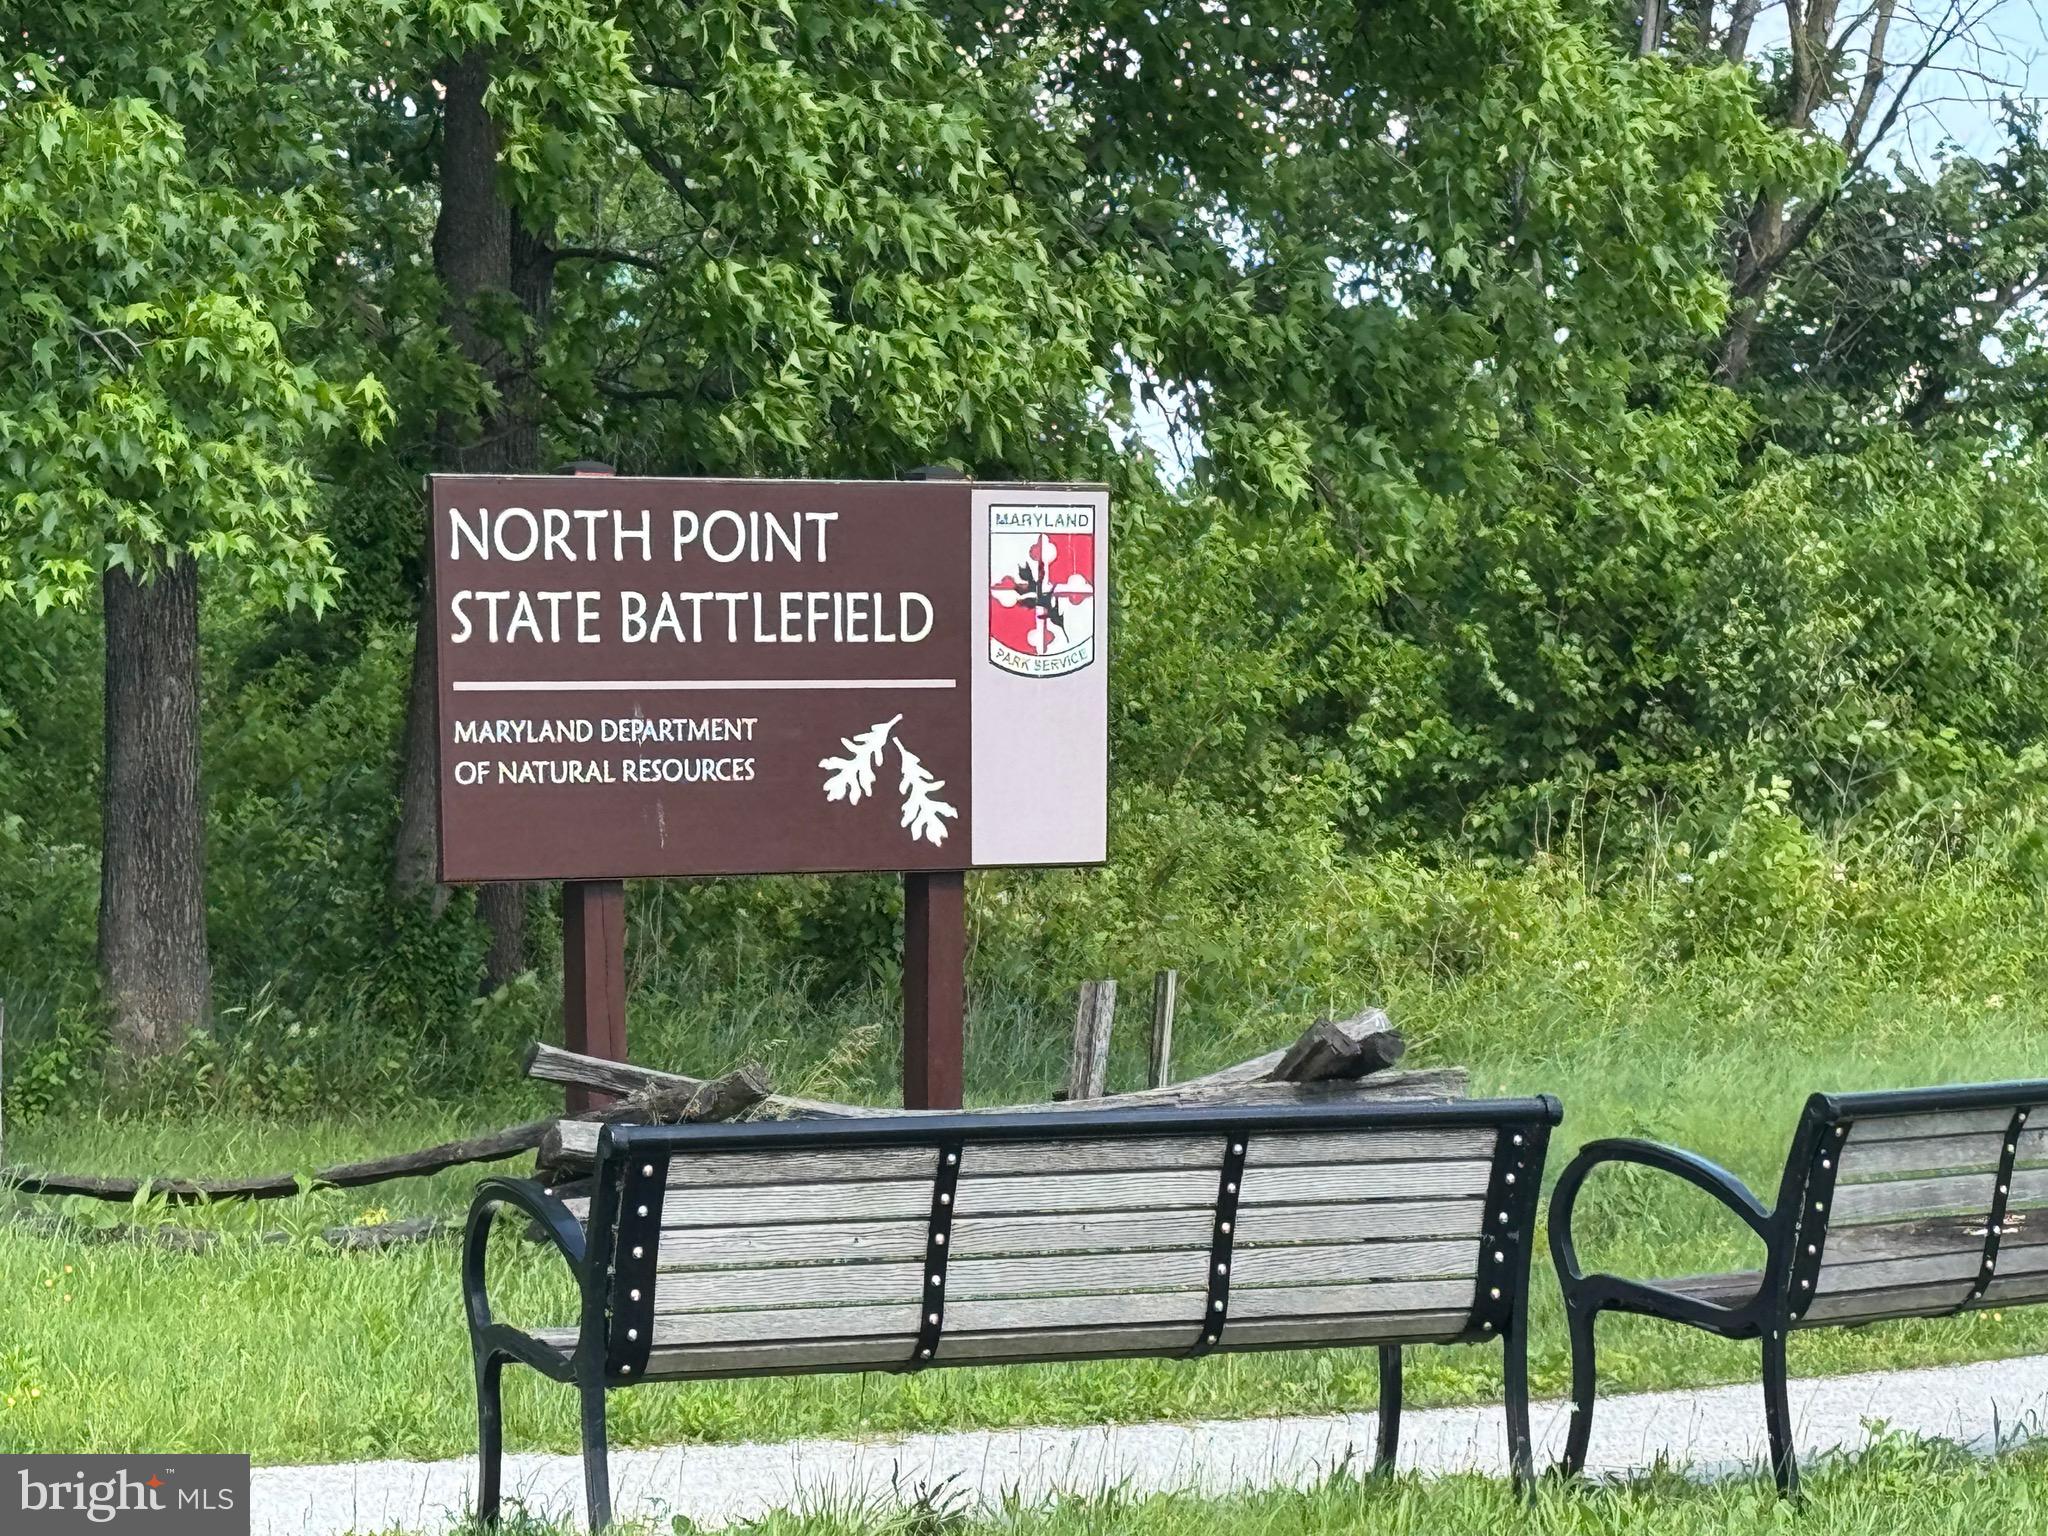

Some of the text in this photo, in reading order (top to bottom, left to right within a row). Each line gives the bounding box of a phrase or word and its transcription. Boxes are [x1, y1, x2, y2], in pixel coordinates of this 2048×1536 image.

[995, 513, 1089, 527] MARYLAND
[449, 507, 839, 563] NORTH POINT
[450, 590, 934, 643] STATE BATTLEFIELD
[996, 647, 1088, 672] PARK SERVICE
[453, 717, 759, 744] MARYLAND DEPARTMENT
[454, 757, 756, 785] OF NATURAL RESOURCES
